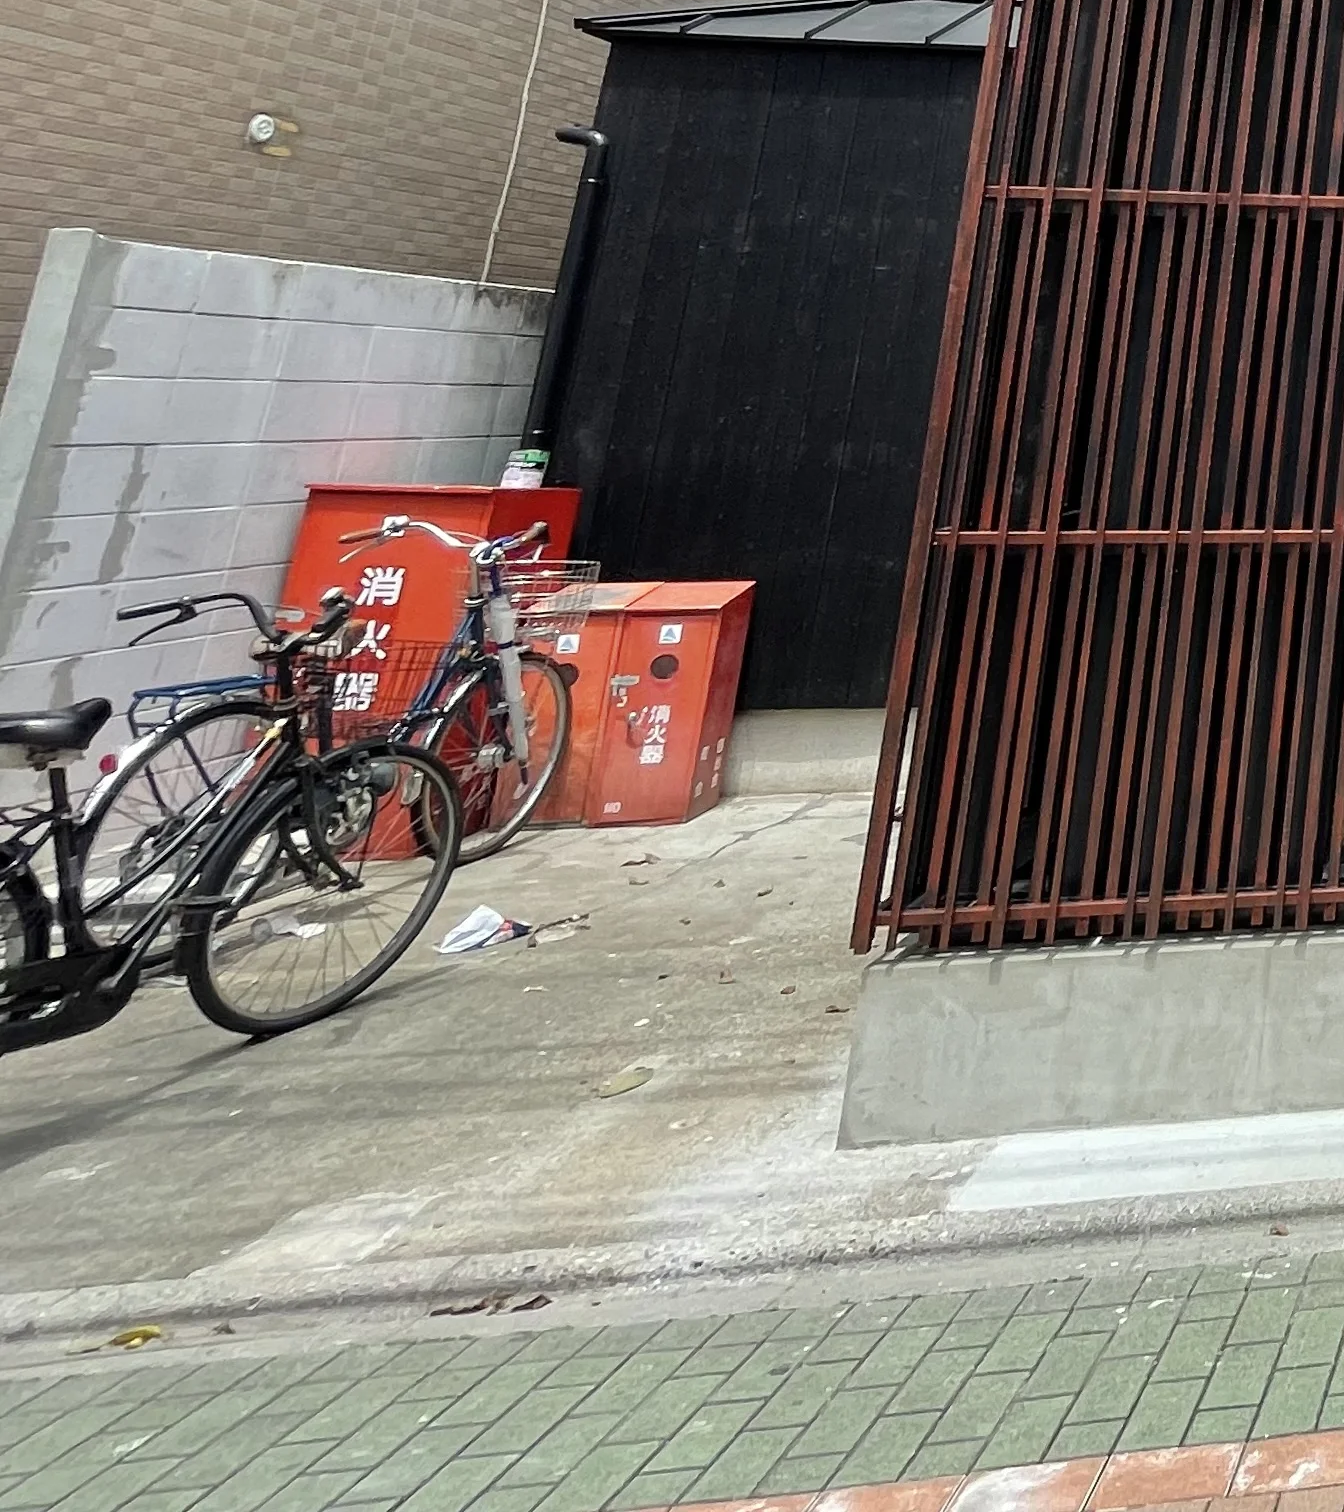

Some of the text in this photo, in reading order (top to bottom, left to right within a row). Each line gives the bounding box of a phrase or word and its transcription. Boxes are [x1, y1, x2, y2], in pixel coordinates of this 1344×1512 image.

[331, 566, 406, 711] 消火器
[639, 704, 672, 765] 消火器
